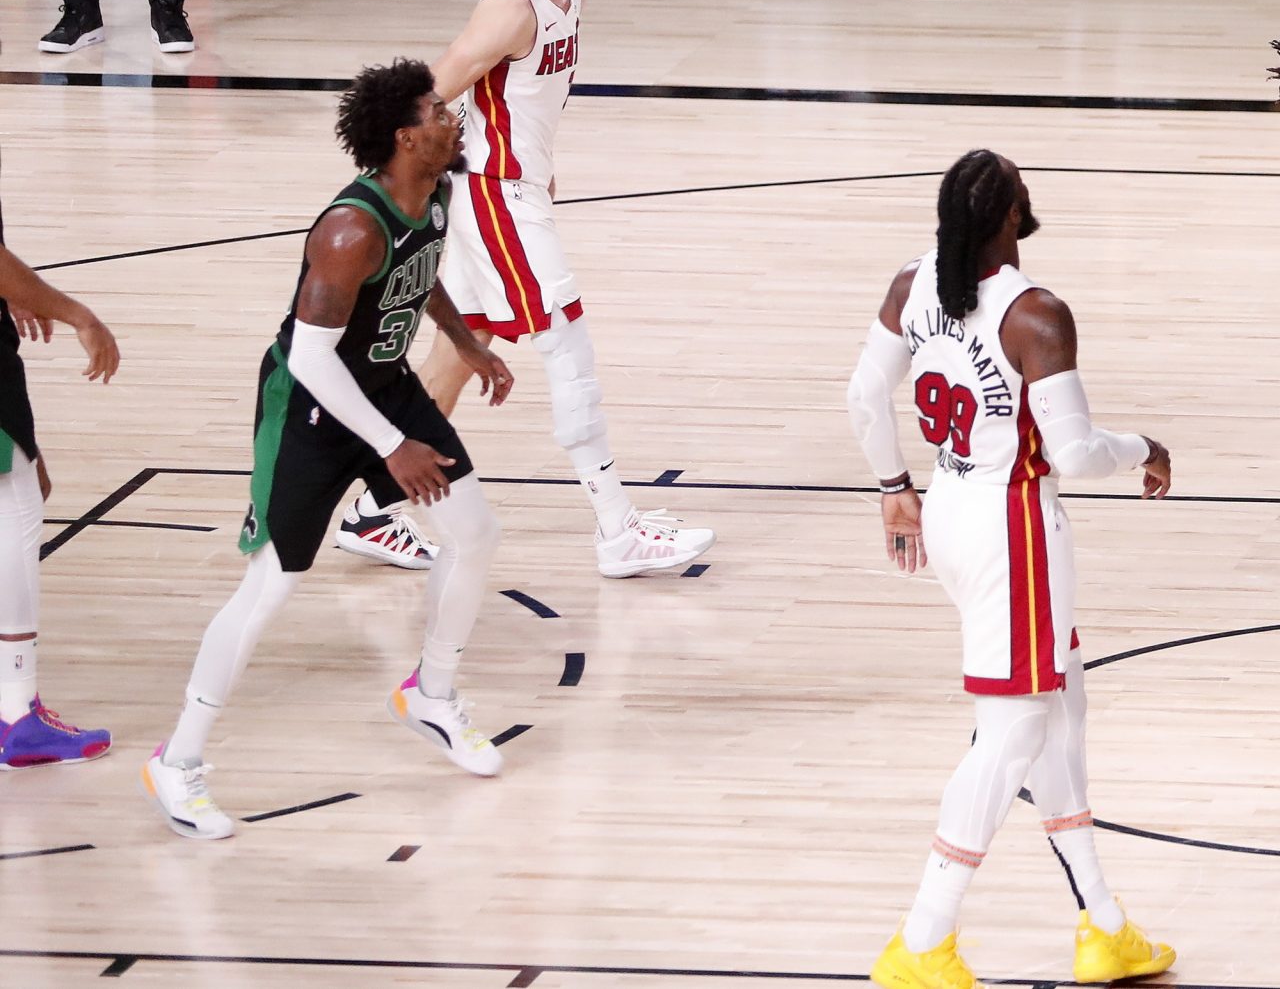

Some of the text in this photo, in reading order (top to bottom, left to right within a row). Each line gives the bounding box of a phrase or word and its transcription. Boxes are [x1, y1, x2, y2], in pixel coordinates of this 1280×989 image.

[926, 307, 966, 343] LIVES
[967, 335, 1014, 417] MATTER
[914, 371, 978, 458] 99
